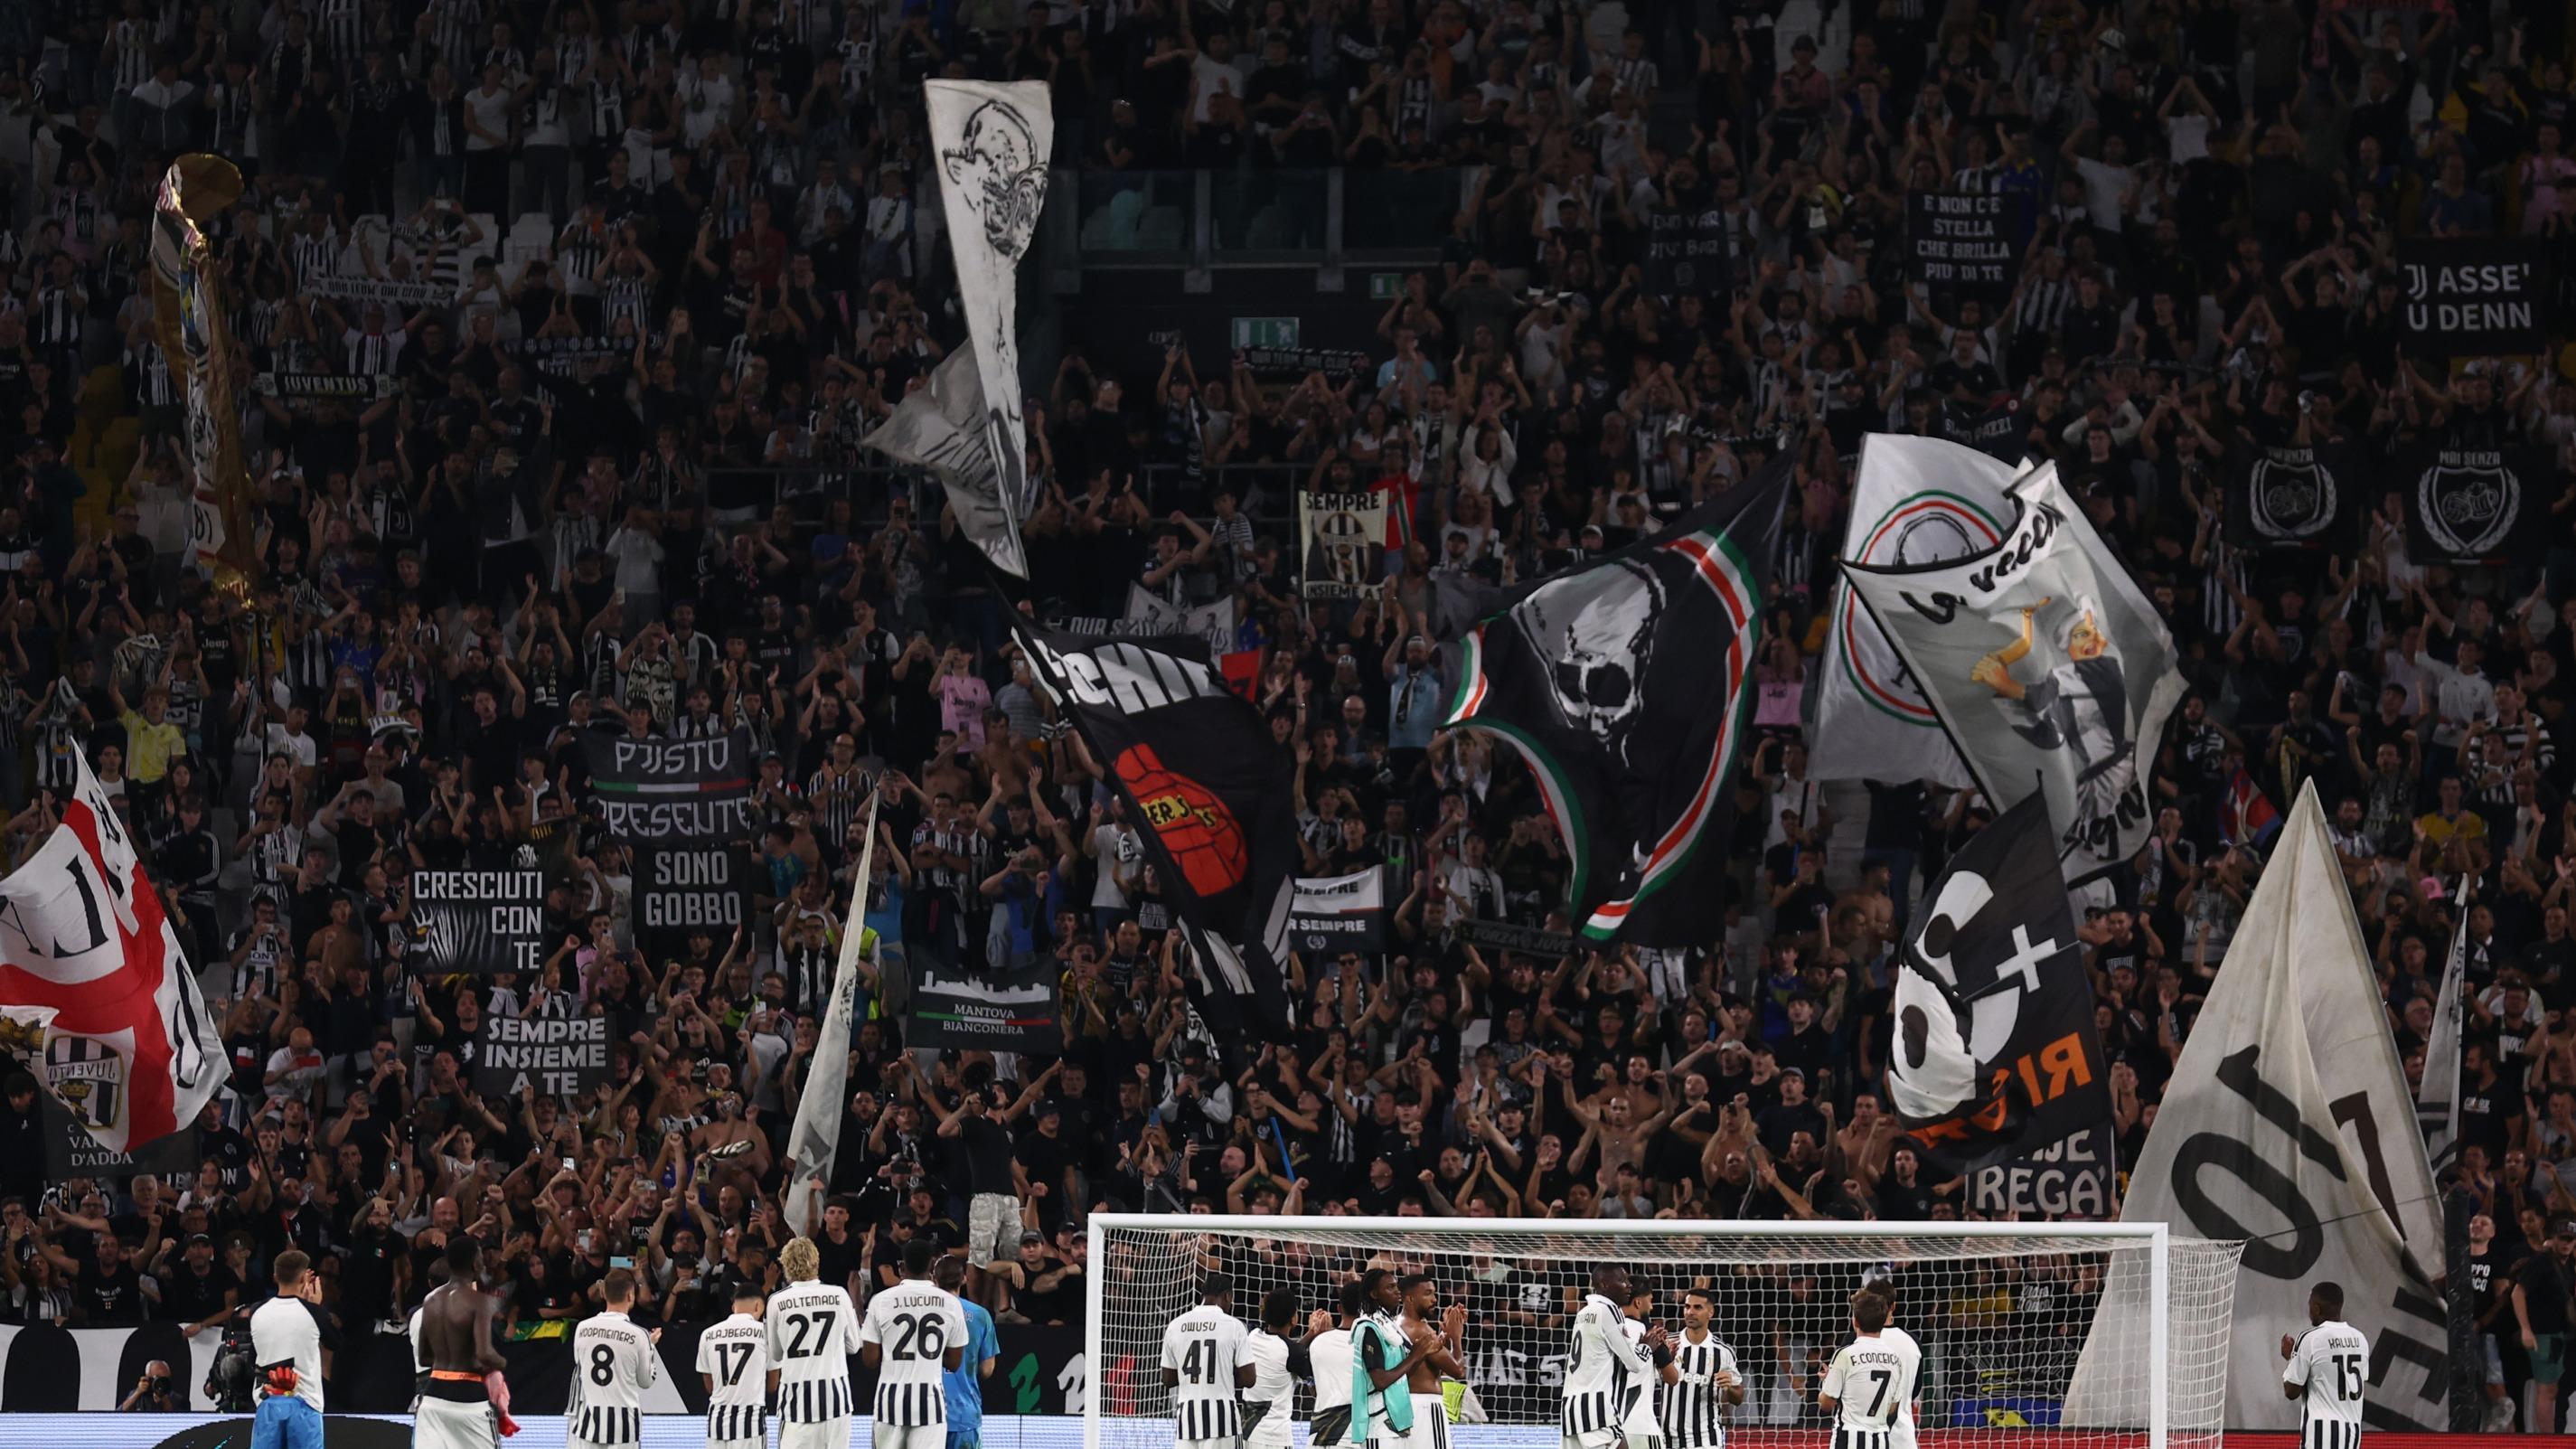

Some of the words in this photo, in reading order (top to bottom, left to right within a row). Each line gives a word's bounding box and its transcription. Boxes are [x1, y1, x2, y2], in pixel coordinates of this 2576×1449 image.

[1923, 194, 1935, 212] E
[1939, 195, 1972, 213] NON
[1932, 218, 1995, 236] STELLA
[1917, 240, 1948, 258] CHE
[1952, 240, 2011, 259] BRILLA
[1960, 265, 1978, 280] DI
[1981, 265, 2004, 281] TE
[2438, 263, 2531, 294] ASSE'
[2408, 305, 2429, 332] U
[2438, 302, 2533, 332] DENN
[284, 375, 369, 392] JUVENTUS
[2440, 450, 2461, 465] MAI
[2463, 450, 2501, 466] SENZA
[1305, 493, 1379, 511] SEMPRE
[1306, 584, 1359, 599] INSIEME
[202, 637, 230, 651] Jeep
[654, 851, 729, 886] SONO
[414, 871, 543, 899] CRESCIUTI
[645, 890, 740, 927] GOBBO
[491, 906, 542, 935] CON
[1300, 918, 1367, 933] SEMPRE
[1472, 926, 1520, 946] FORZA
[512, 941, 541, 969] TE
[952, 1002, 1015, 1020] MANTOVA
[487, 1017, 606, 1044] SEMPRE
[942, 1020, 1024, 1035] BIANCONERA
[484, 1044, 607, 1069] INSIEME
[510, 1072, 531, 1095] A
[541, 1072, 579, 1095] TE
[71, 1152, 134, 1167] D'ADDA
[1976, 1164, 2107, 1216] REGA'
[778, 1295, 841, 1312] WOLTEMADE
[893, 1295, 945, 1309] J.LUCUMI
[578, 1327, 636, 1344] KOOPMEINERS
[705, 1328, 764, 1342] ALAJBEGOVI
[785, 1312, 836, 1360] 27
[892, 1313, 945, 1361] 26
[1180, 1322, 1217, 1333] OWUSU
[2328, 1337, 2359, 1350] KALULU
[591, 1343, 615, 1386] 8
[715, 1342, 756, 1388] 17
[1181, 1340, 1217, 1384] 41
[1678, 1368, 1710, 1387] Jeep
[2332, 1353, 2364, 1401] 15
[1867, 1369, 1892, 1416] 7
